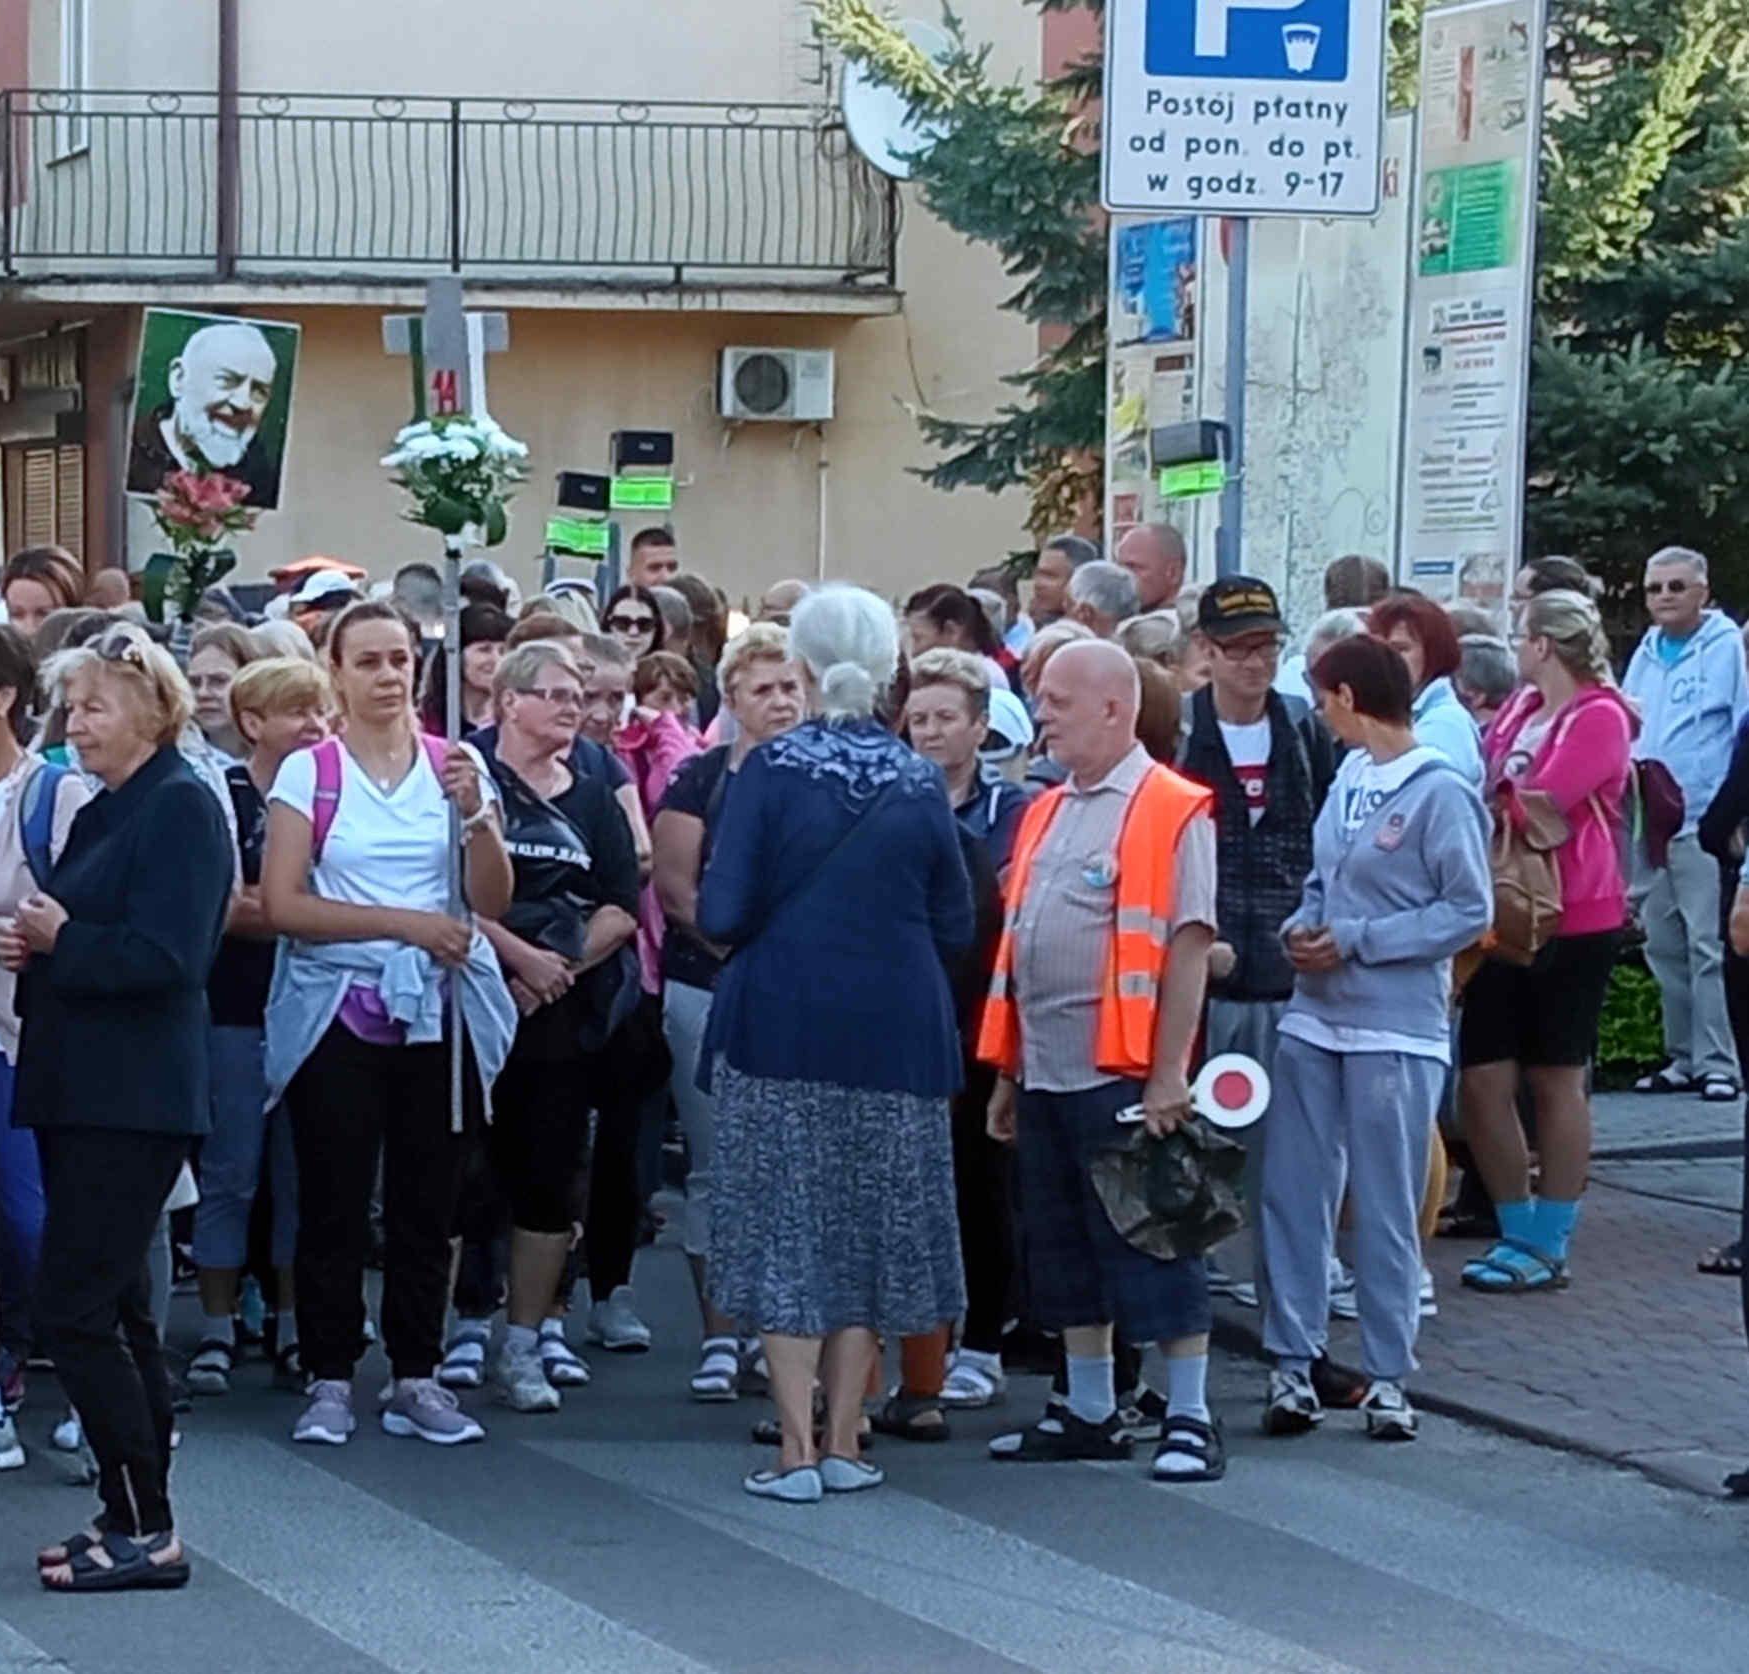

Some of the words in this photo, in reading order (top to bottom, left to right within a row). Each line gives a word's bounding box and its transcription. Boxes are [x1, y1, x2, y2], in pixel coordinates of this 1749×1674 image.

[1145, 88, 1235, 125] Postój
[1253, 96, 1349, 128] płatny
[1129, 130, 1166, 153] od
[1185, 135, 1249, 162] pon.
[1268, 135, 1305, 158] do
[1324, 139, 1361, 166] pt.
[1147, 173, 1168, 192] w
[1187, 170, 1265, 200] godz.
[1284, 171, 1345, 198] 9-17
